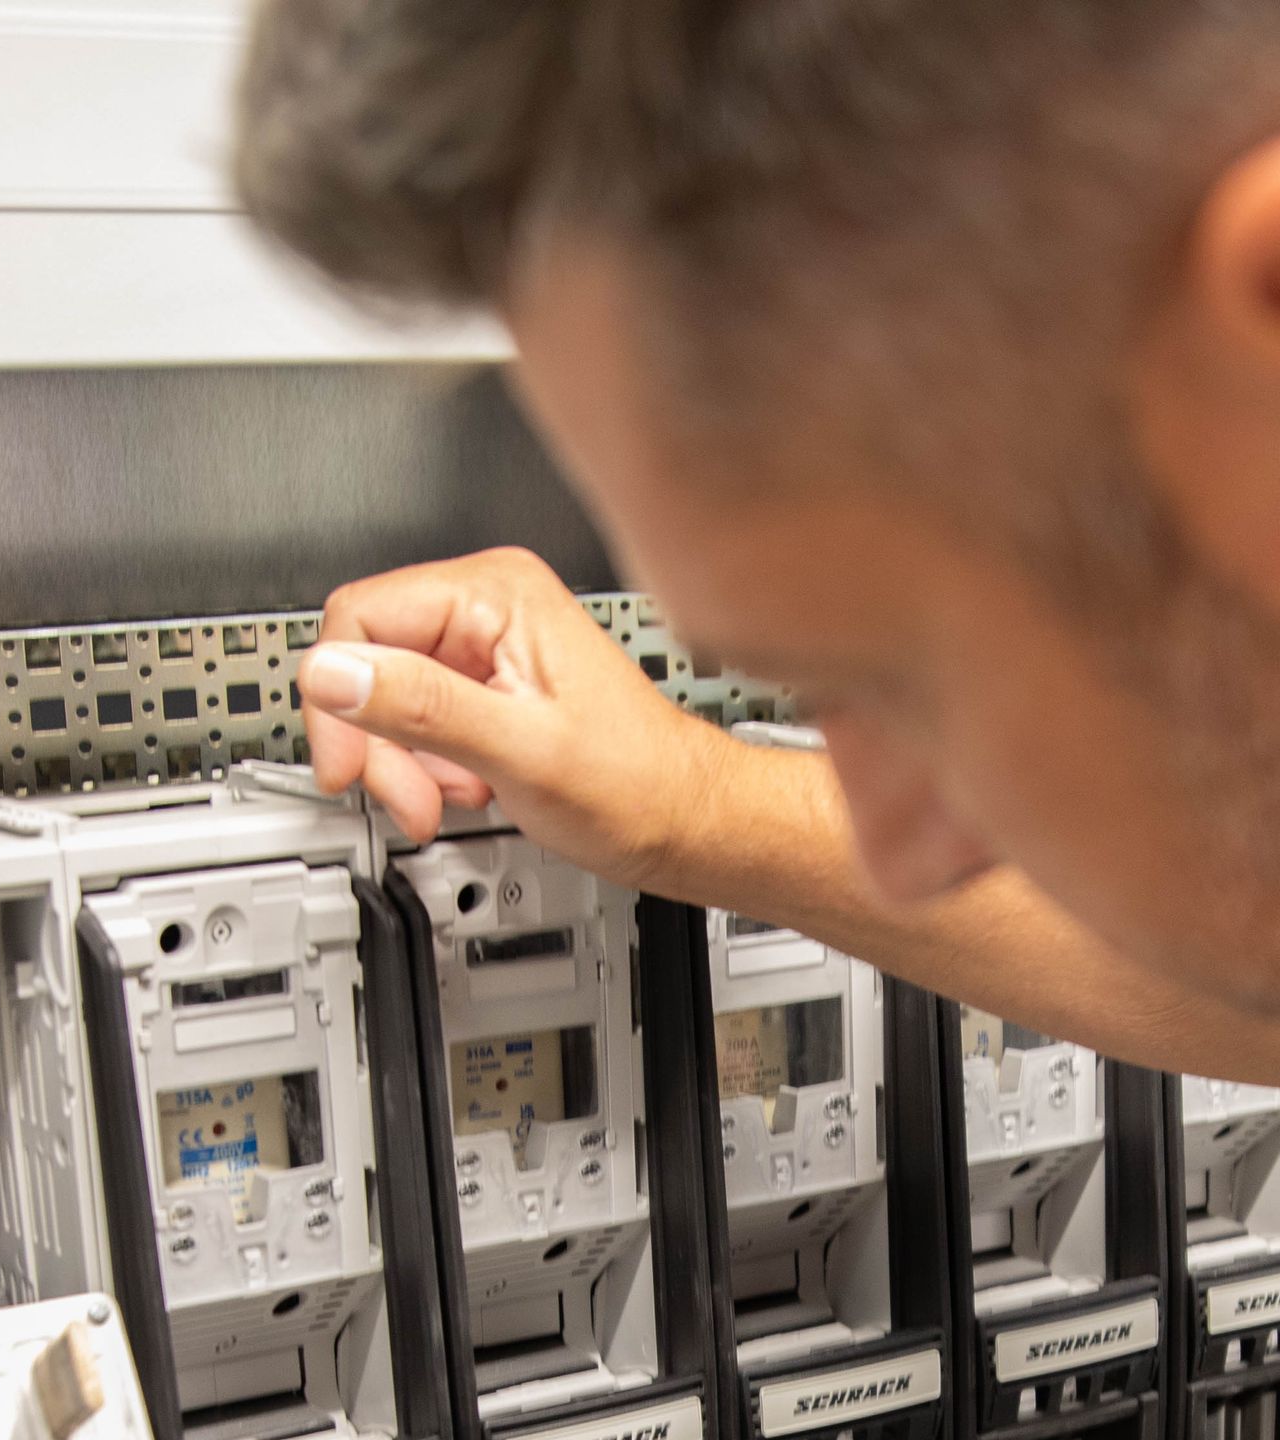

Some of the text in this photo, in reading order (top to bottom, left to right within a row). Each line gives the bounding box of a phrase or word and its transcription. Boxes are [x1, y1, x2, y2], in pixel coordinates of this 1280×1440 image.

[176, 1088, 214, 1106] 315A
[1025, 1321, 1134, 1362] SCHRACK
[793, 1372, 913, 1416] SCHRACK
